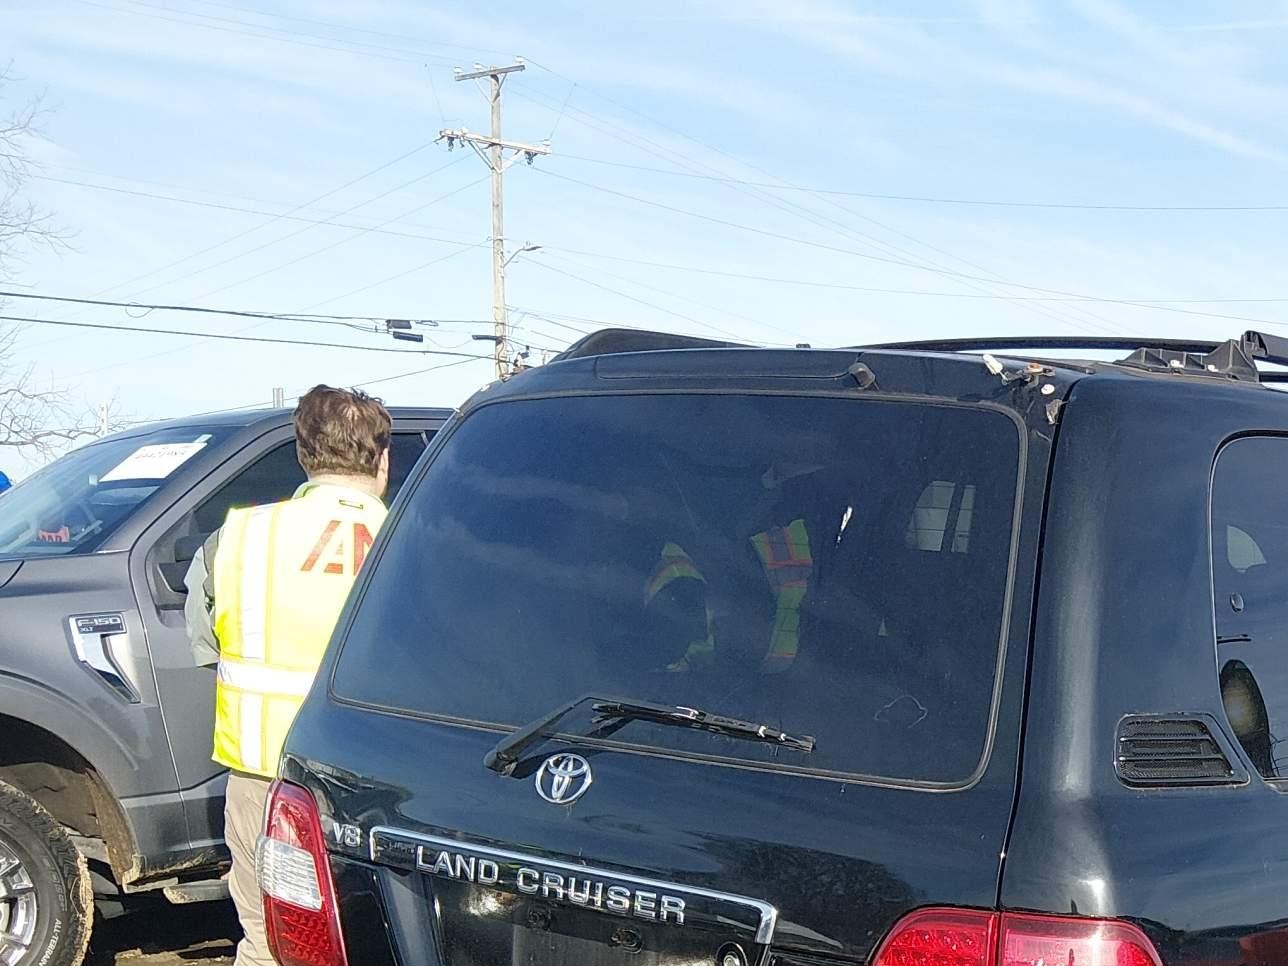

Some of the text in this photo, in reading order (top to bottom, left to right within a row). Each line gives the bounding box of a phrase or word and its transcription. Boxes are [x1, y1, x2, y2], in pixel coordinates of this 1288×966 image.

[78, 617, 121, 627] F-150
[333, 822, 362, 848] V8
[415, 845, 686, 925] LAND CRUISER
